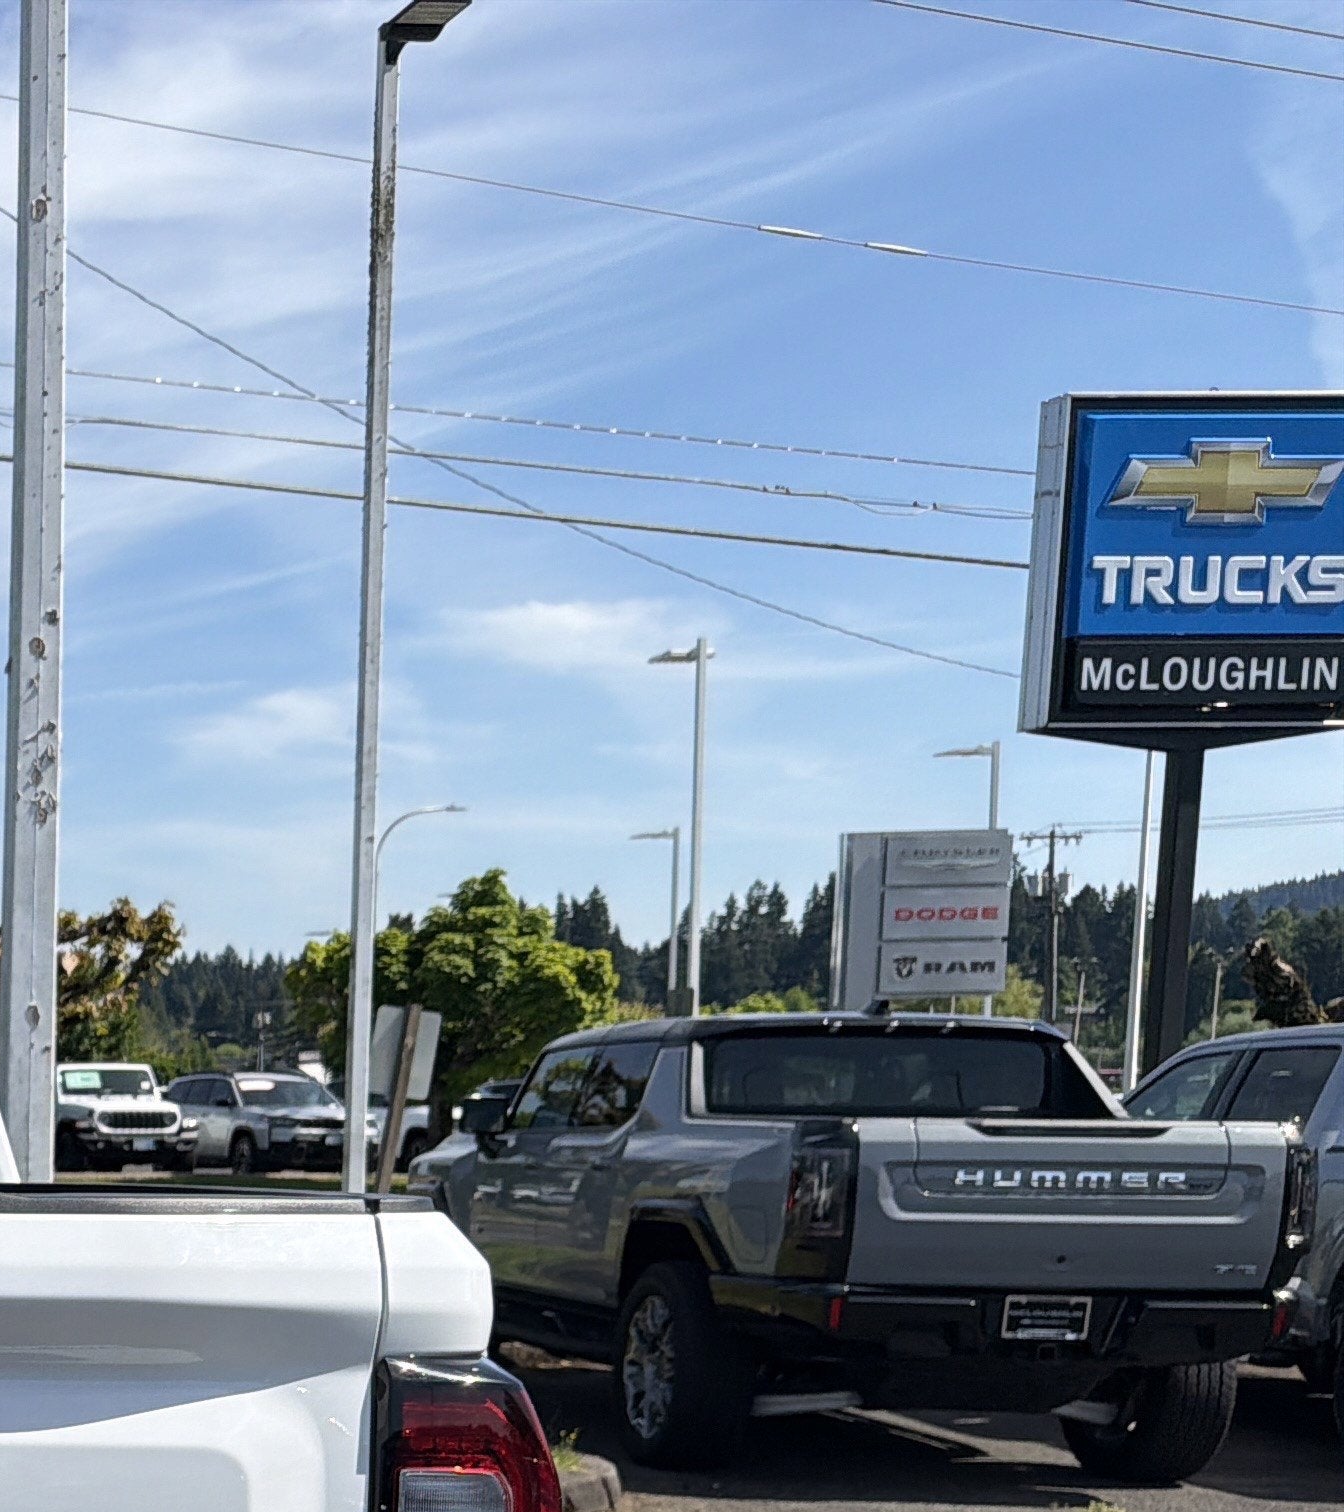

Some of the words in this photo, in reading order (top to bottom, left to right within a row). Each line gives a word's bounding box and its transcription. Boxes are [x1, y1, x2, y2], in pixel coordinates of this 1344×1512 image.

[1092, 555, 1344, 605] TRUCKS
[1080, 656, 1339, 692] McLOUGHLIN
[895, 906, 999, 921] DODGE
[923, 961, 996, 973] RAM
[955, 1168, 1187, 1190] HUMMER
